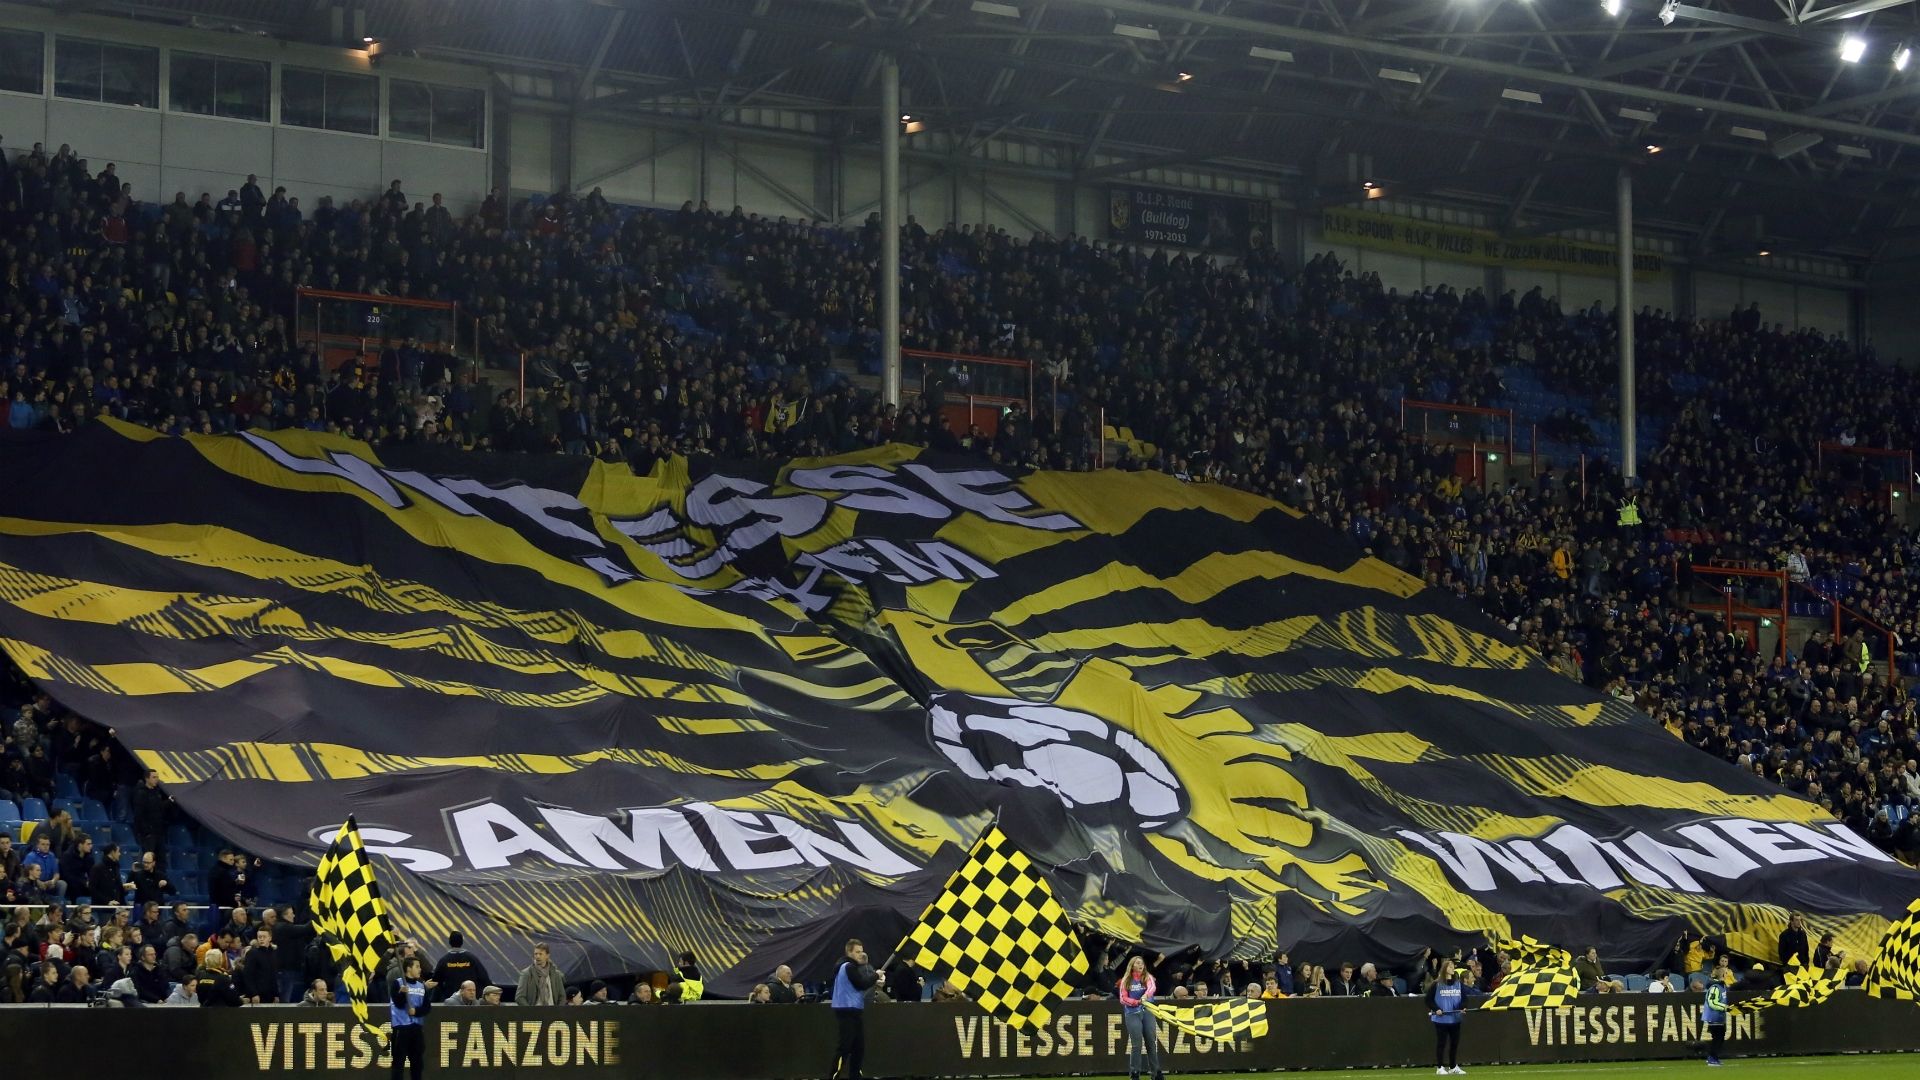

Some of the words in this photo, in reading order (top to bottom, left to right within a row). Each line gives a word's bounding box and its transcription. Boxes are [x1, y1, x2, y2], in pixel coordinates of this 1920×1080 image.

[1141, 209, 1190, 230] (Bulldog)
[367, 315, 381, 324] 220
[319, 801, 923, 876] SAMEN
[1396, 819, 1894, 893] WINNEN
[439, 1020, 619, 1068] FANZONE
[1524, 1005, 1638, 1046] VITESSE
